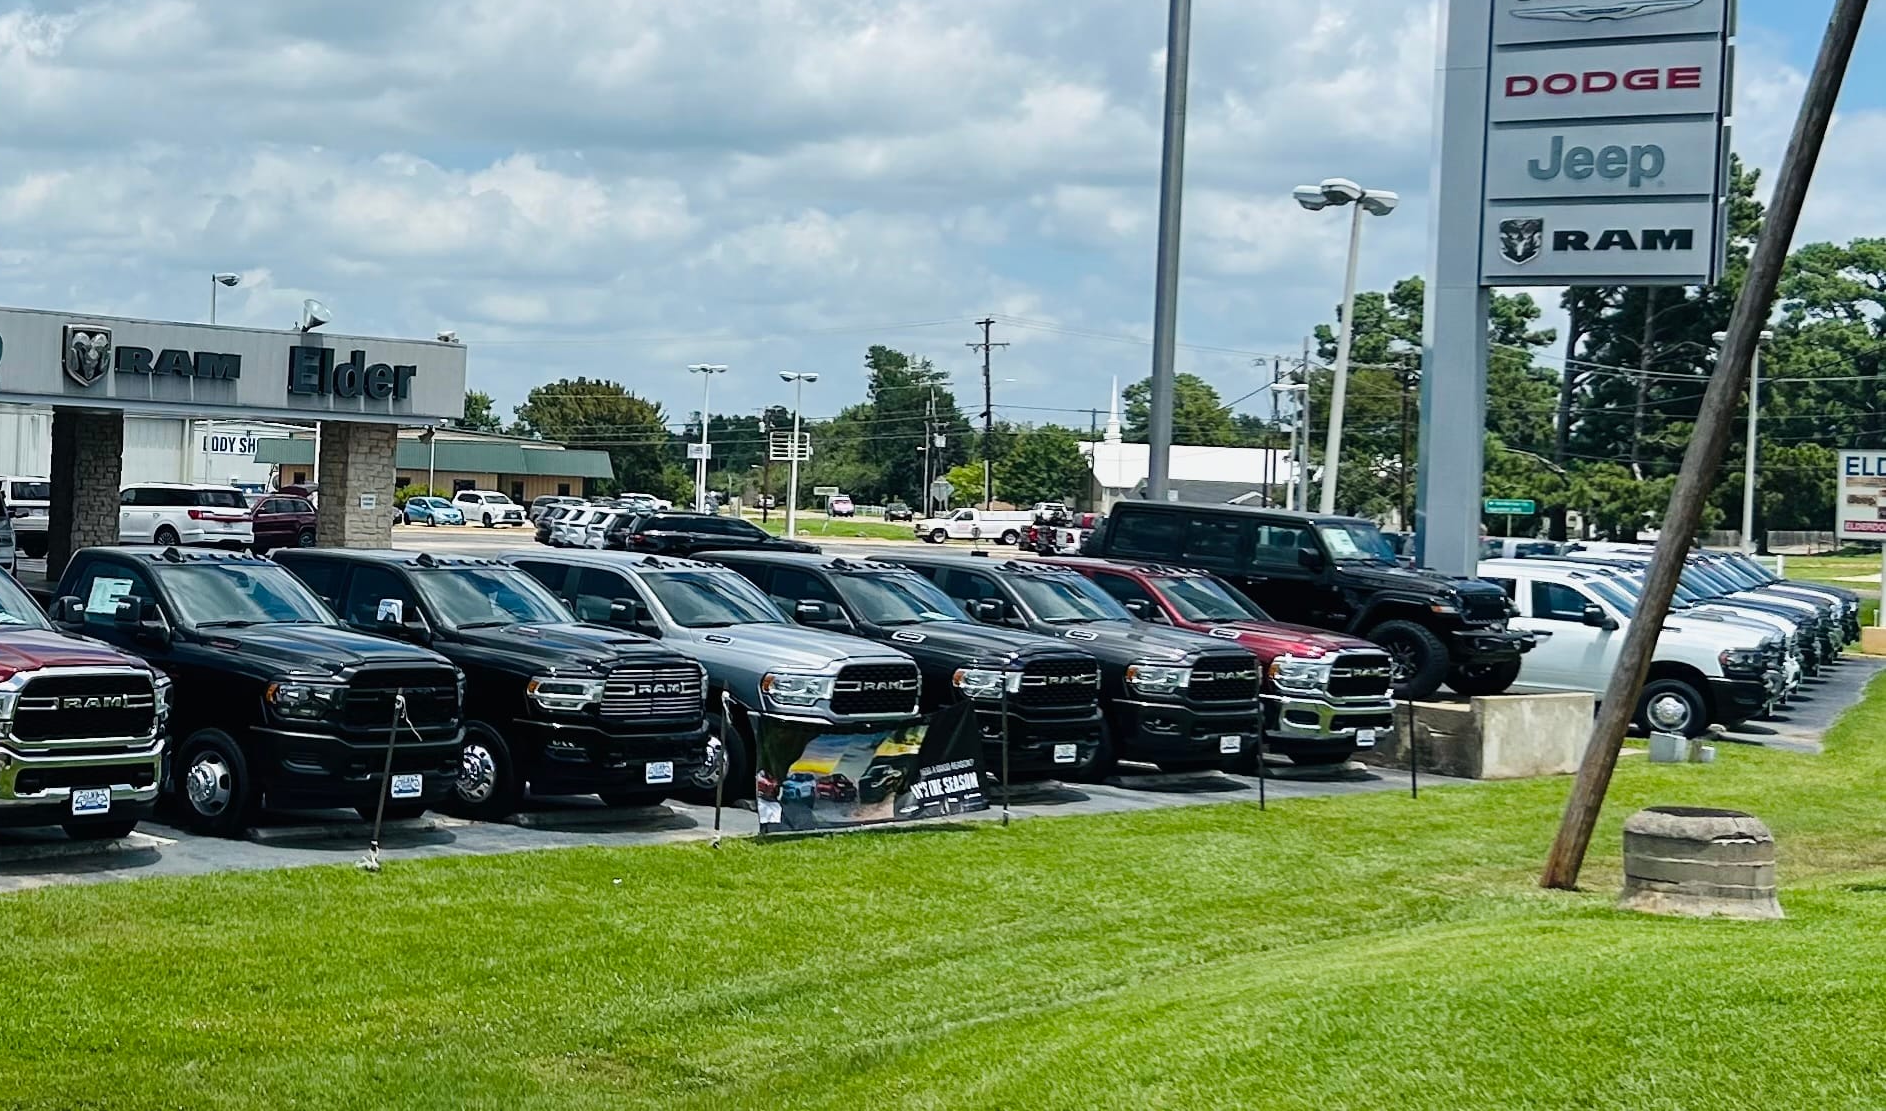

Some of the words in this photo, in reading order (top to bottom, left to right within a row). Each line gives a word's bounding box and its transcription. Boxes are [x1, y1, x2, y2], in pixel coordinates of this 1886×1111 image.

[1505, 67, 1702, 97] DODGE
[1527, 136, 1665, 188] Jeep
[1552, 229, 1694, 251] RAM
[115, 346, 242, 379] RAM
[288, 345, 417, 399] Elder
[638, 683, 680, 694] RAM
[863, 681, 900, 690] RAM
[1048, 675, 1081, 685] RAM
[63, 696, 122, 709] RAM
[943, 772, 979, 793] SEASON
